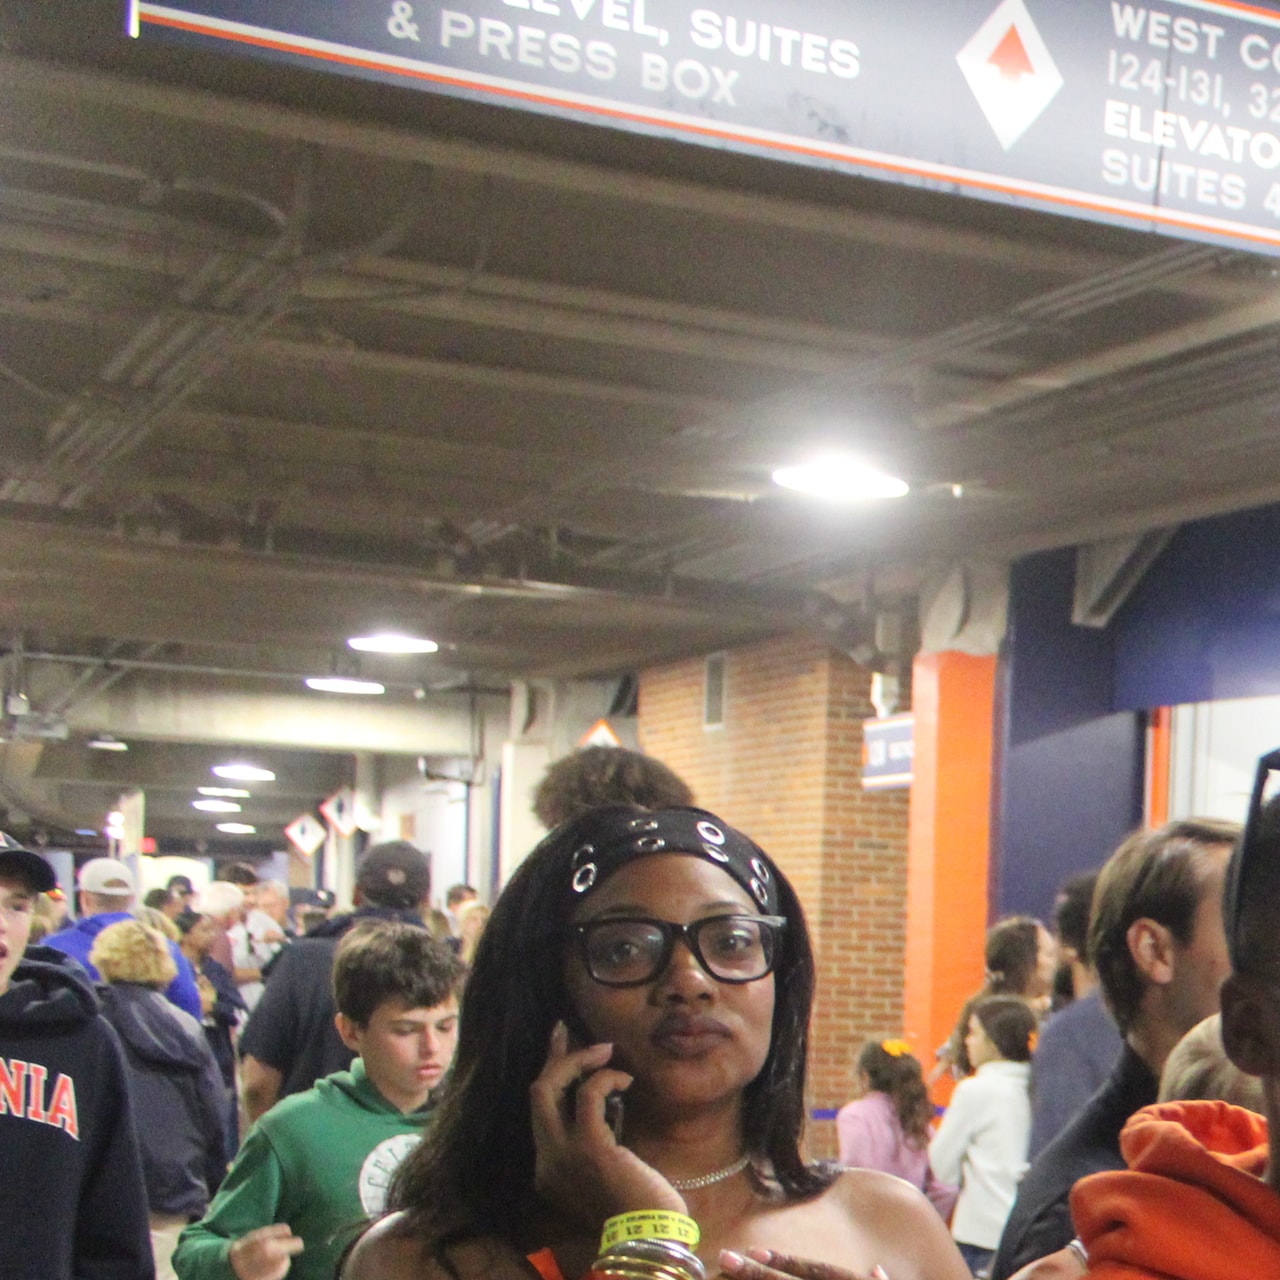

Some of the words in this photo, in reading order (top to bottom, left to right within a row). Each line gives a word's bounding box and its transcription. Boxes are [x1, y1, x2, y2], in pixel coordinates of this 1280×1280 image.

[387, 0, 420, 42] &
[440, 9, 617, 80] PRESS
[641, 53, 739, 105] BOX
[507, 0, 670, 46] VEL,
[691, 10, 860, 79] SUITES
[1111, 3, 1224, 59] WEST
[1108, 49, 1231, 118] 124-131,
[1101, 149, 1246, 209] SUITES
